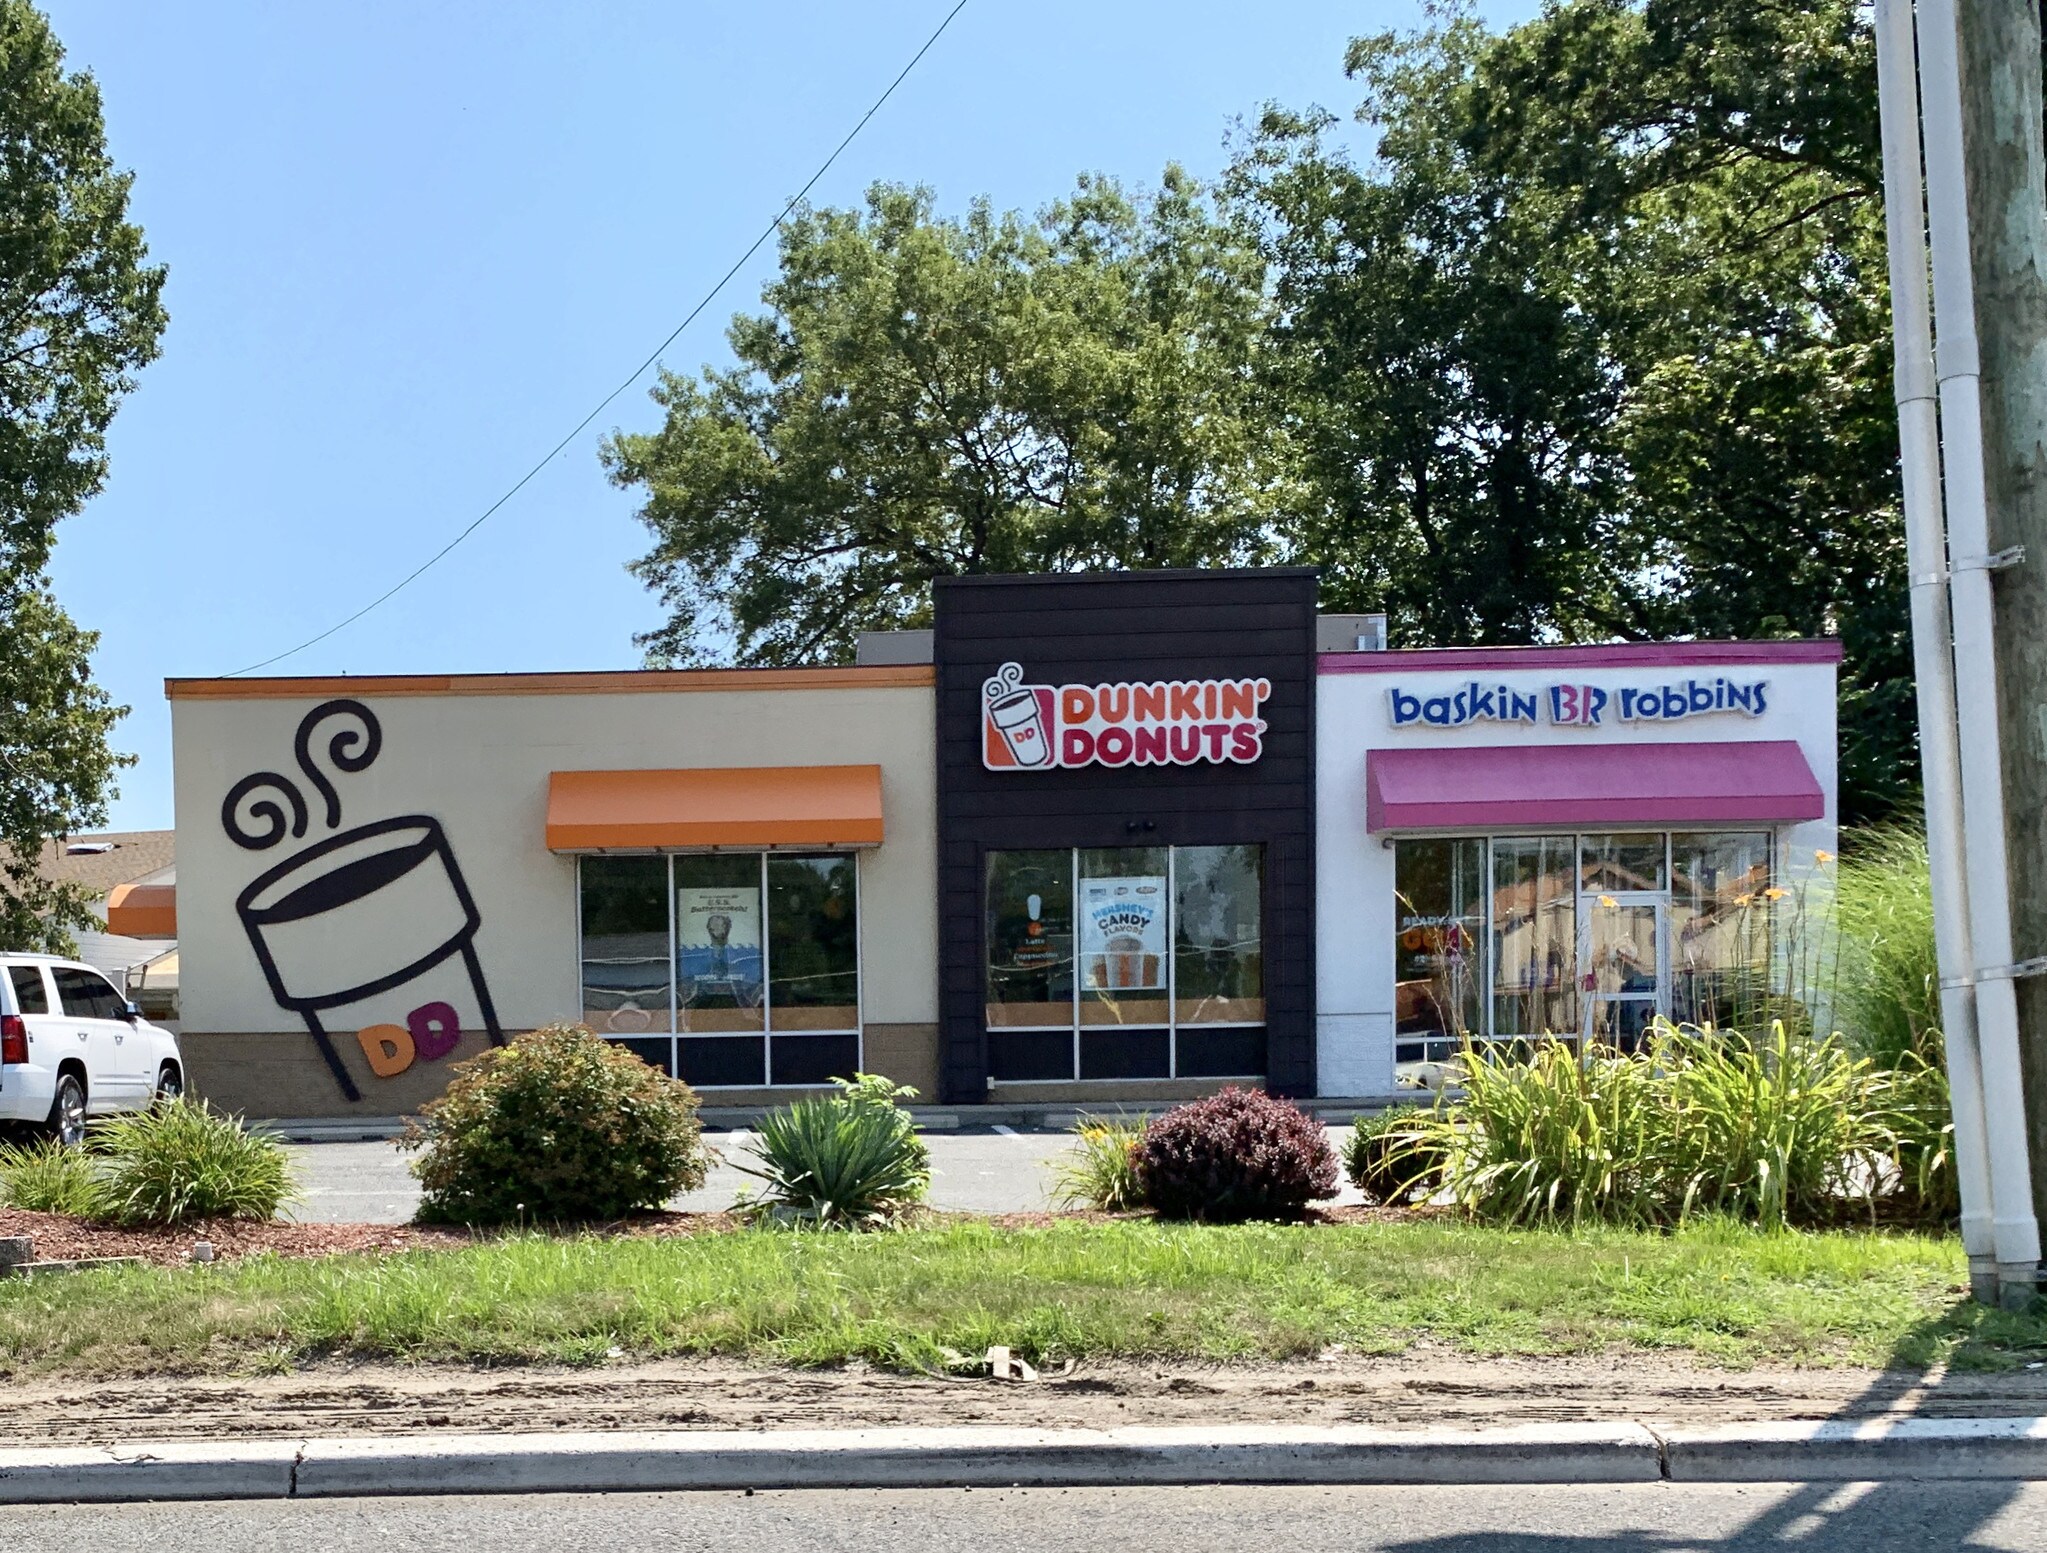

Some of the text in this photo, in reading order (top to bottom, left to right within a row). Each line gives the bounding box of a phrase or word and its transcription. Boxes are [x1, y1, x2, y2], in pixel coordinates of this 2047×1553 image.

[1063, 682, 1268, 724] DUNKIN'
[1013, 727, 1035, 744] DD
[1063, 723, 1258, 765] DONUTS
[1098, 913, 1150, 930] CANDY
[1103, 925, 1144, 938] FLAVORS
[357, 1001, 461, 1078] DD
